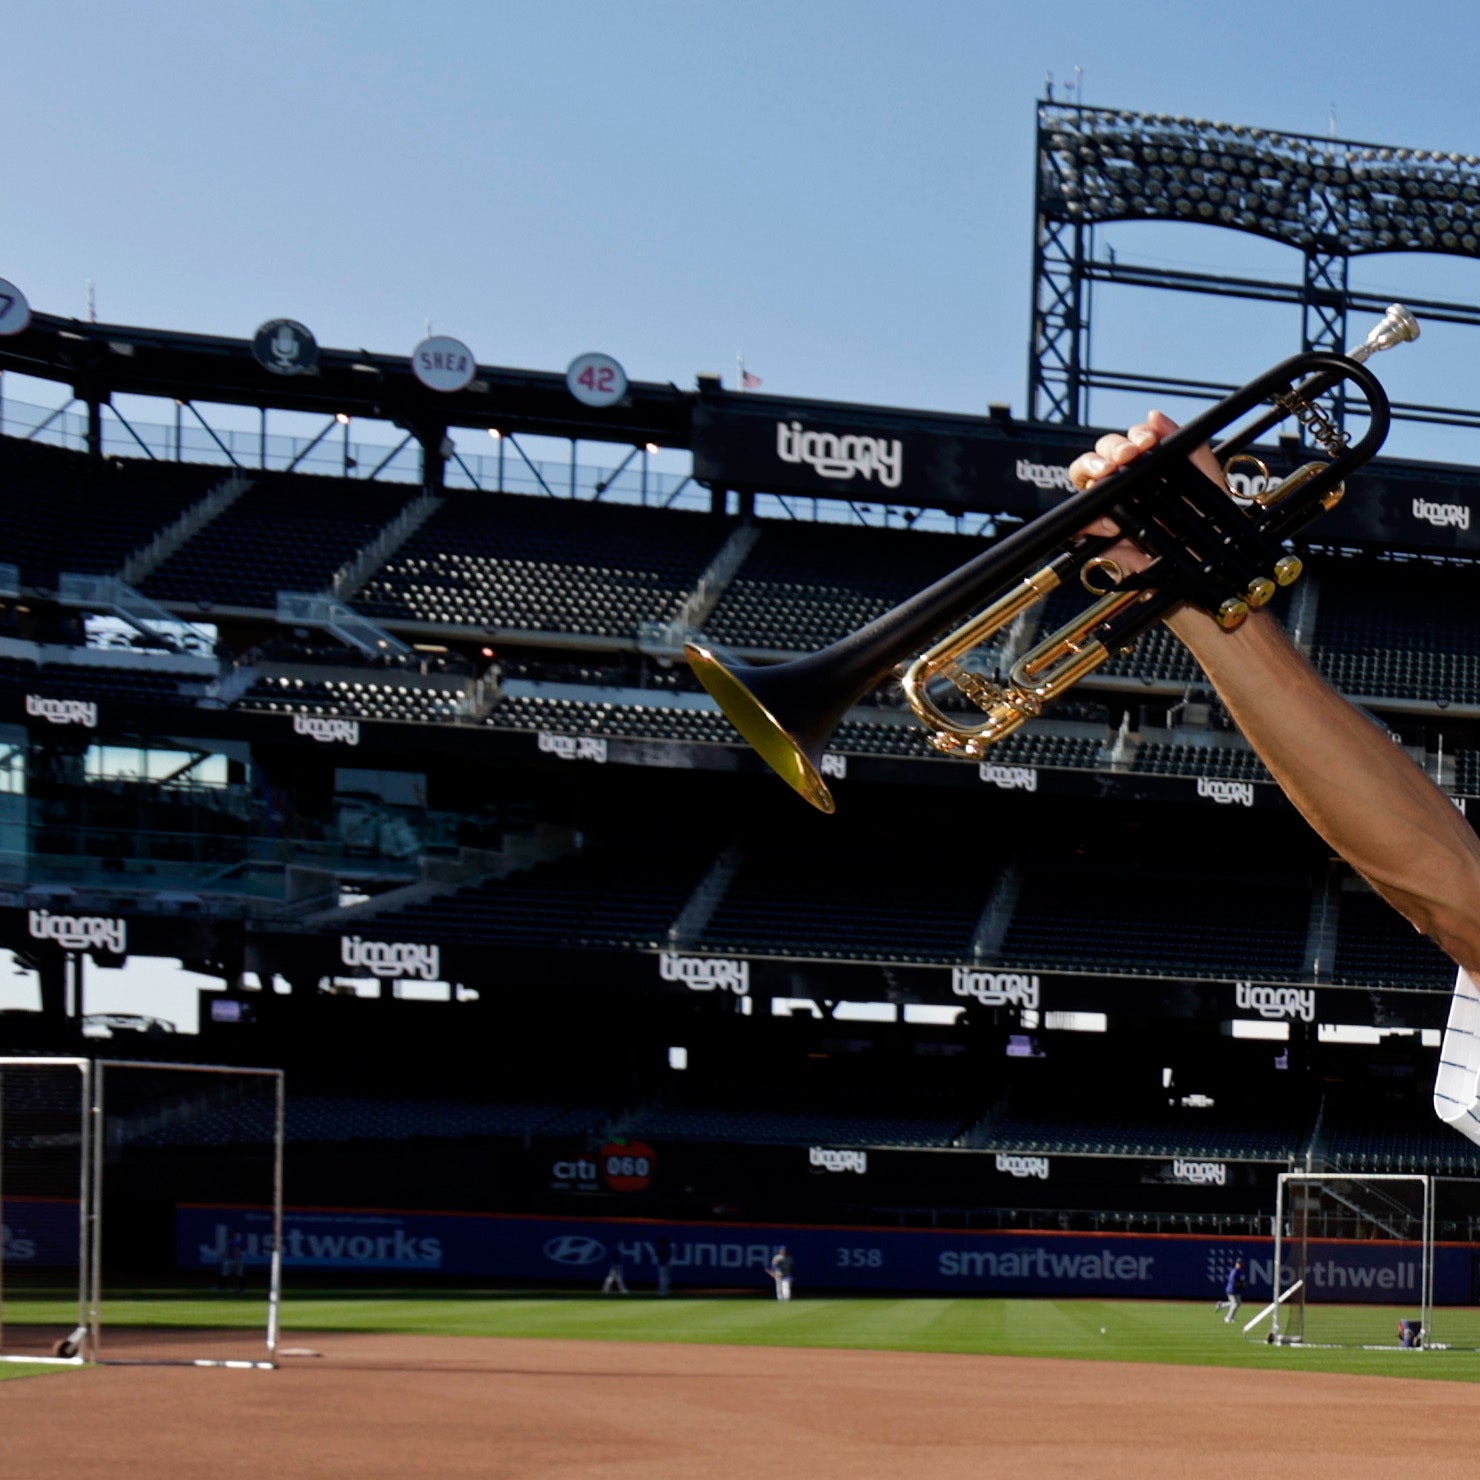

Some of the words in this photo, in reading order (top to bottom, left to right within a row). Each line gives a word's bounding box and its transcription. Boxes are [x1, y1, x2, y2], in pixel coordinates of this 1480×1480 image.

[420, 353, 467, 374] SHEA
[578, 365, 616, 394] 42
[776, 421, 903, 488] timmy
[1412, 498, 1470, 530] timmy
[1197, 777, 1253, 807] timmy
[29, 909, 126, 953] timmy
[341, 936, 439, 980] timmy
[659, 952, 749, 995] timmy
[952, 967, 1039, 1009] timmy
[1235, 981, 1315, 1023] timmy
[1174, 1159, 1226, 1185] timmy
[837, 1249, 882, 1267] 358
[938, 1248, 1153, 1280] smartwater
[1249, 1259, 1414, 1289] Northwell
